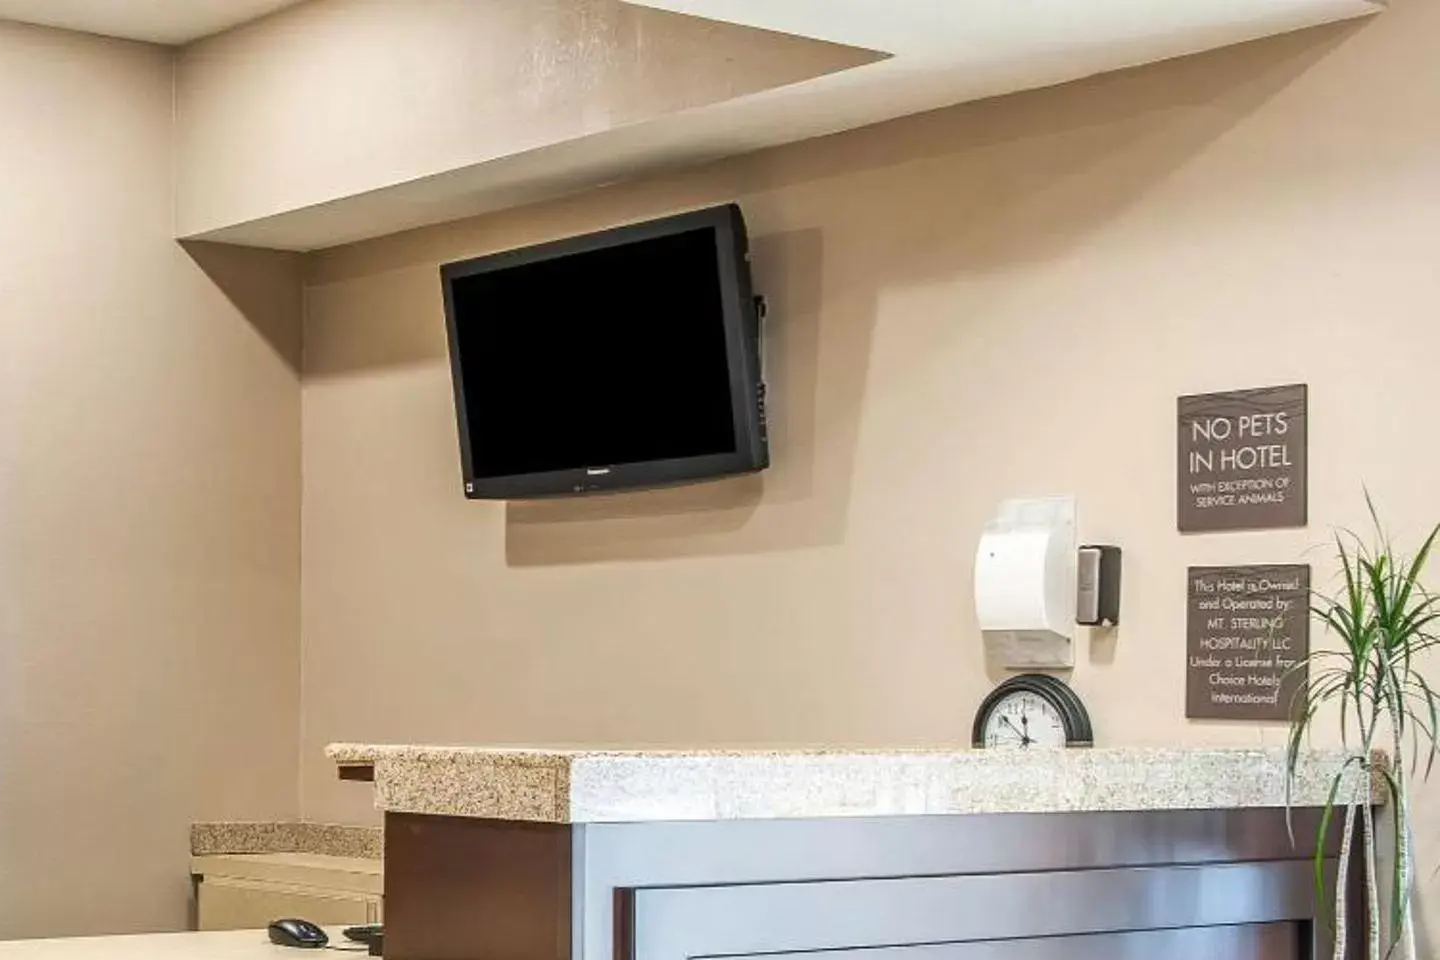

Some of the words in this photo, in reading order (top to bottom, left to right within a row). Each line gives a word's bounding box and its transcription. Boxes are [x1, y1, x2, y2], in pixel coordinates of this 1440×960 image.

[1192, 417, 1232, 442] NO
[1238, 411, 1289, 439] PETS
[1189, 449, 1213, 474] IN
[1220, 444, 1292, 471] HOTEL
[1189, 482, 1216, 495] WITH
[1218, 478, 1274, 493] EXCEPTION
[1275, 476, 1290, 489] OF
[1195, 495, 1235, 508] SERVICE
[1239, 490, 1285, 505] ANIMALS
[1194, 579, 1215, 593] This
[1217, 578, 1245, 593] Hotel
[1259, 577, 1300, 592] Owned
[1199, 597, 1220, 610] and
[1222, 597, 1274, 611] Operated
[1231, 616, 1284, 629] STERLING
[1200, 637, 1268, 650] HOSPITALITY
[1272, 637, 1291, 650] LLC
[1189, 654, 1220, 667] Under
[1235, 655, 1273, 667] License
[1209, 672, 1245, 685] Choice
[1247, 672, 1281, 687] Hotels
[1210, 690, 1278, 704] International
